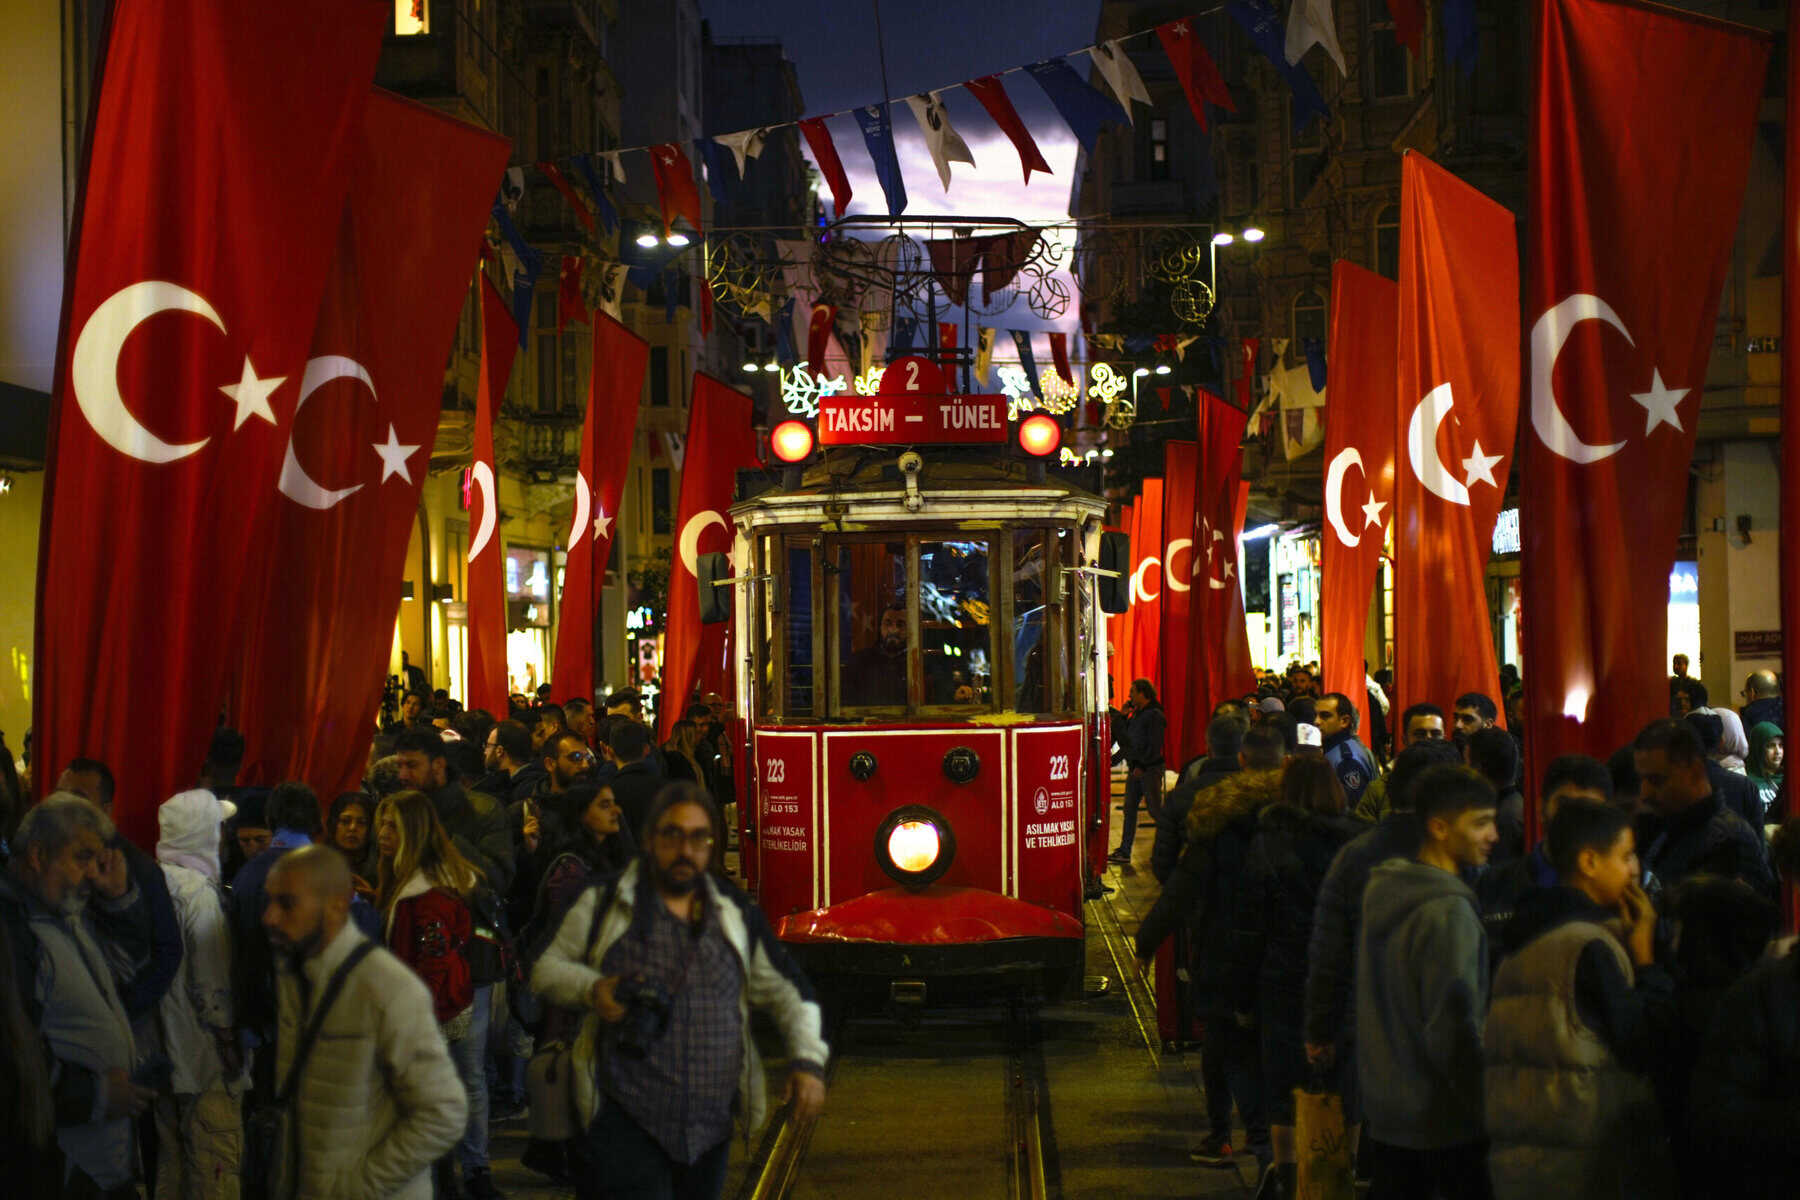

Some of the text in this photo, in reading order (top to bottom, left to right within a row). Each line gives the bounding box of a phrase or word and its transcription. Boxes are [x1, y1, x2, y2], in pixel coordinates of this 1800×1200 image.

[905, 361, 920, 391] 2
[825, 401, 895, 432] TAKSİM
[940, 398, 1001, 428] TÜNEL
[767, 758, 785, 783] 223
[1050, 755, 1069, 780] 223
[785, 804, 799, 813] 153
[1050, 800, 1064, 809] ALO
[782, 826, 806, 836] YASAK
[1026, 822, 1060, 835] ASILMAK
[1025, 837, 1036, 849] VE
